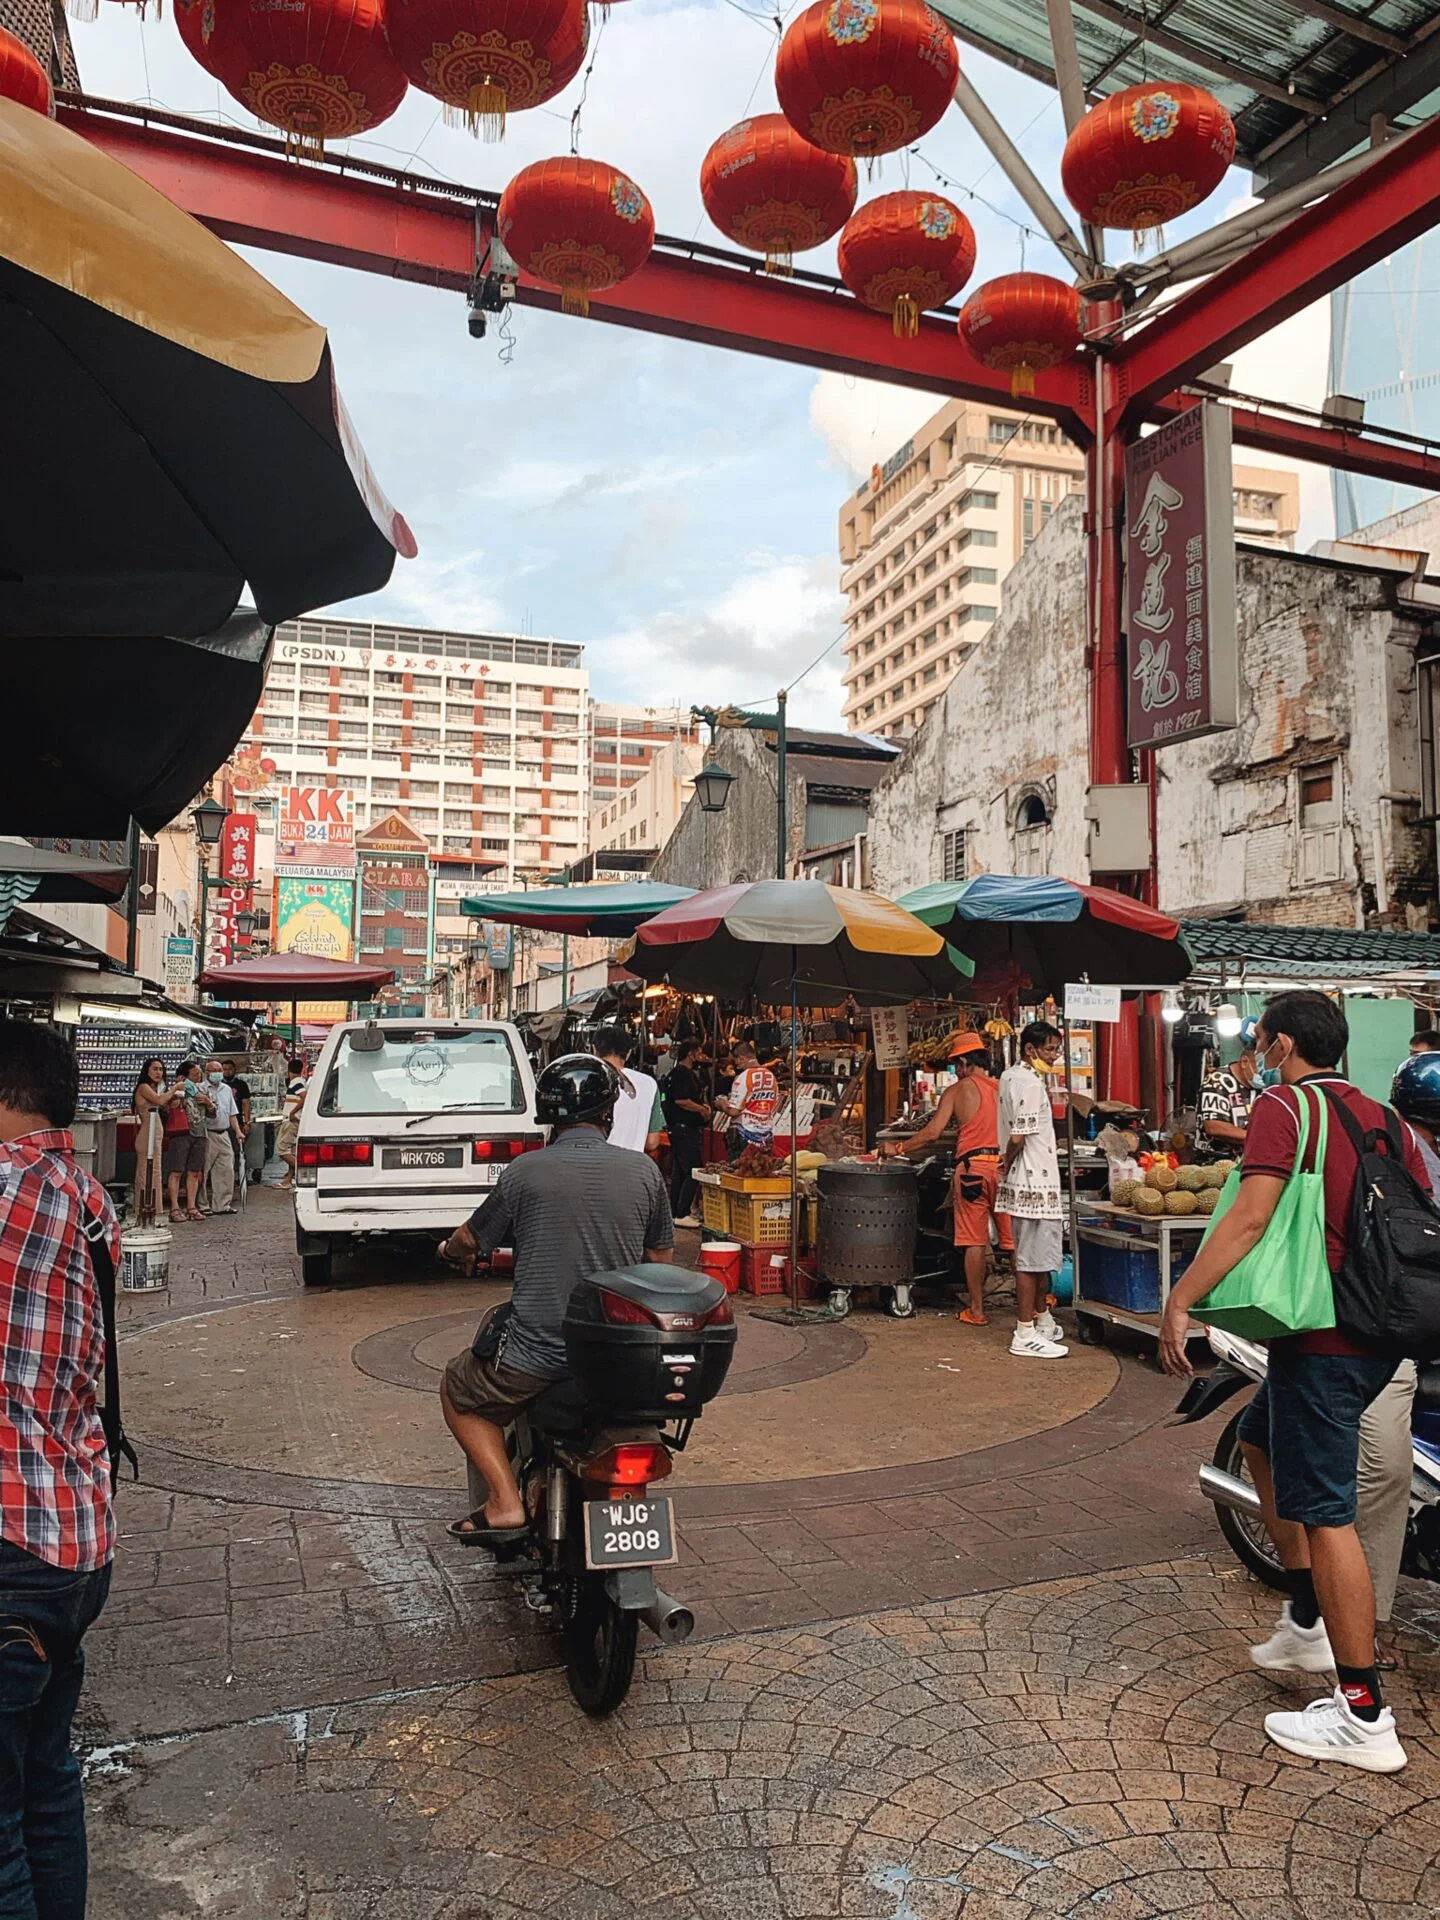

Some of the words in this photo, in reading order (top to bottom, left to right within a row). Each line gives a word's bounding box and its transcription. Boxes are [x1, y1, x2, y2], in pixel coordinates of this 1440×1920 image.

[1181, 426, 1203, 450] KEE
[1175, 709, 1202, 731] 1927
[289, 787, 345, 822] KK
[281, 823, 304, 839] BUKA
[306, 824, 327, 840] 24
[329, 825, 352, 841] JAM
[372, 843, 412, 851] KOSMETIK
[275, 866, 315, 875] KELUARGA
[316, 868, 354, 878] MALAYSIA
[364, 871, 427, 887] CLARA
[597, 871, 621, 880] WISMA
[751, 1071, 774, 1090] 93
[672, 1318, 693, 1326] GIVI
[604, 1529, 660, 1552] 2808
